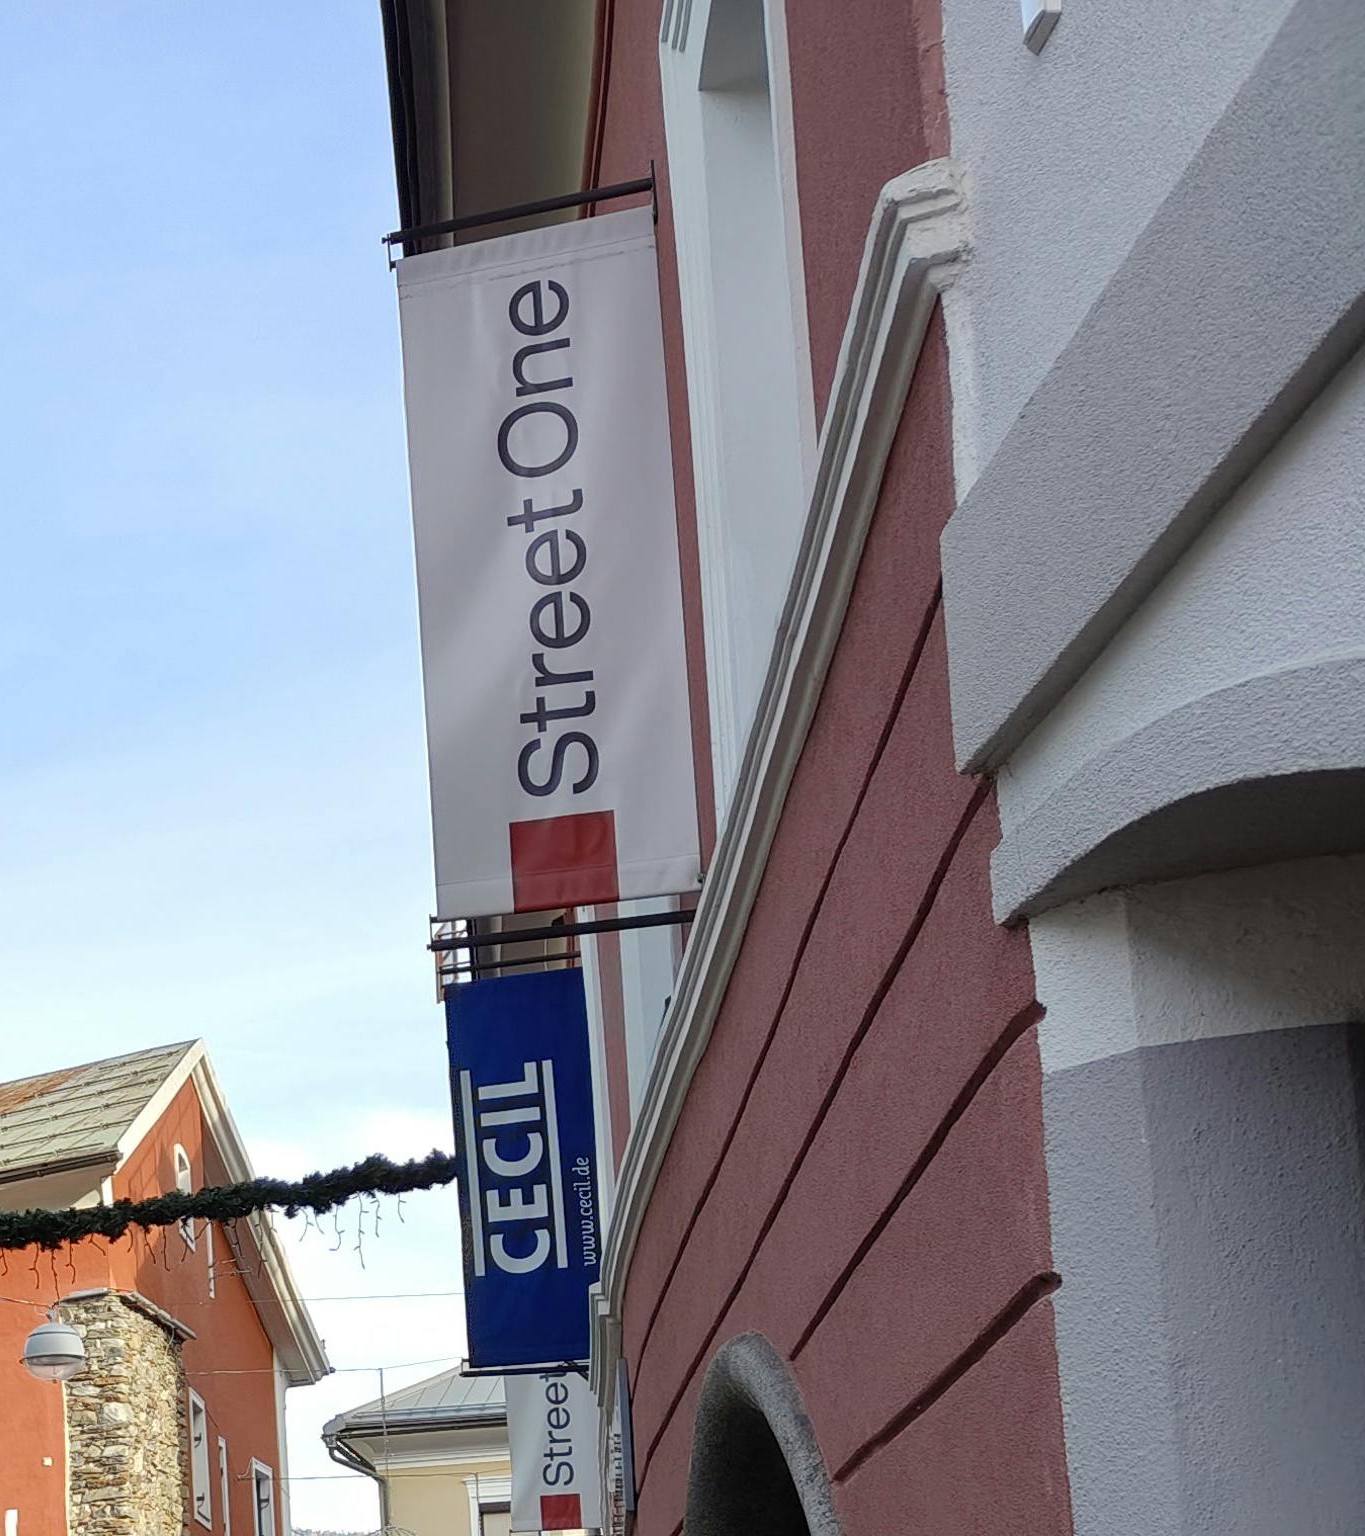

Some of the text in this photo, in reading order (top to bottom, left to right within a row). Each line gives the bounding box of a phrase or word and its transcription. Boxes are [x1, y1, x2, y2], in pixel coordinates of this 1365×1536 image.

[497, 278, 600, 797] Street One
[477, 1060, 552, 1275] CECIL
[572, 1155, 599, 1269] www.cecil.de
[538, 1371, 575, 1487] Street
